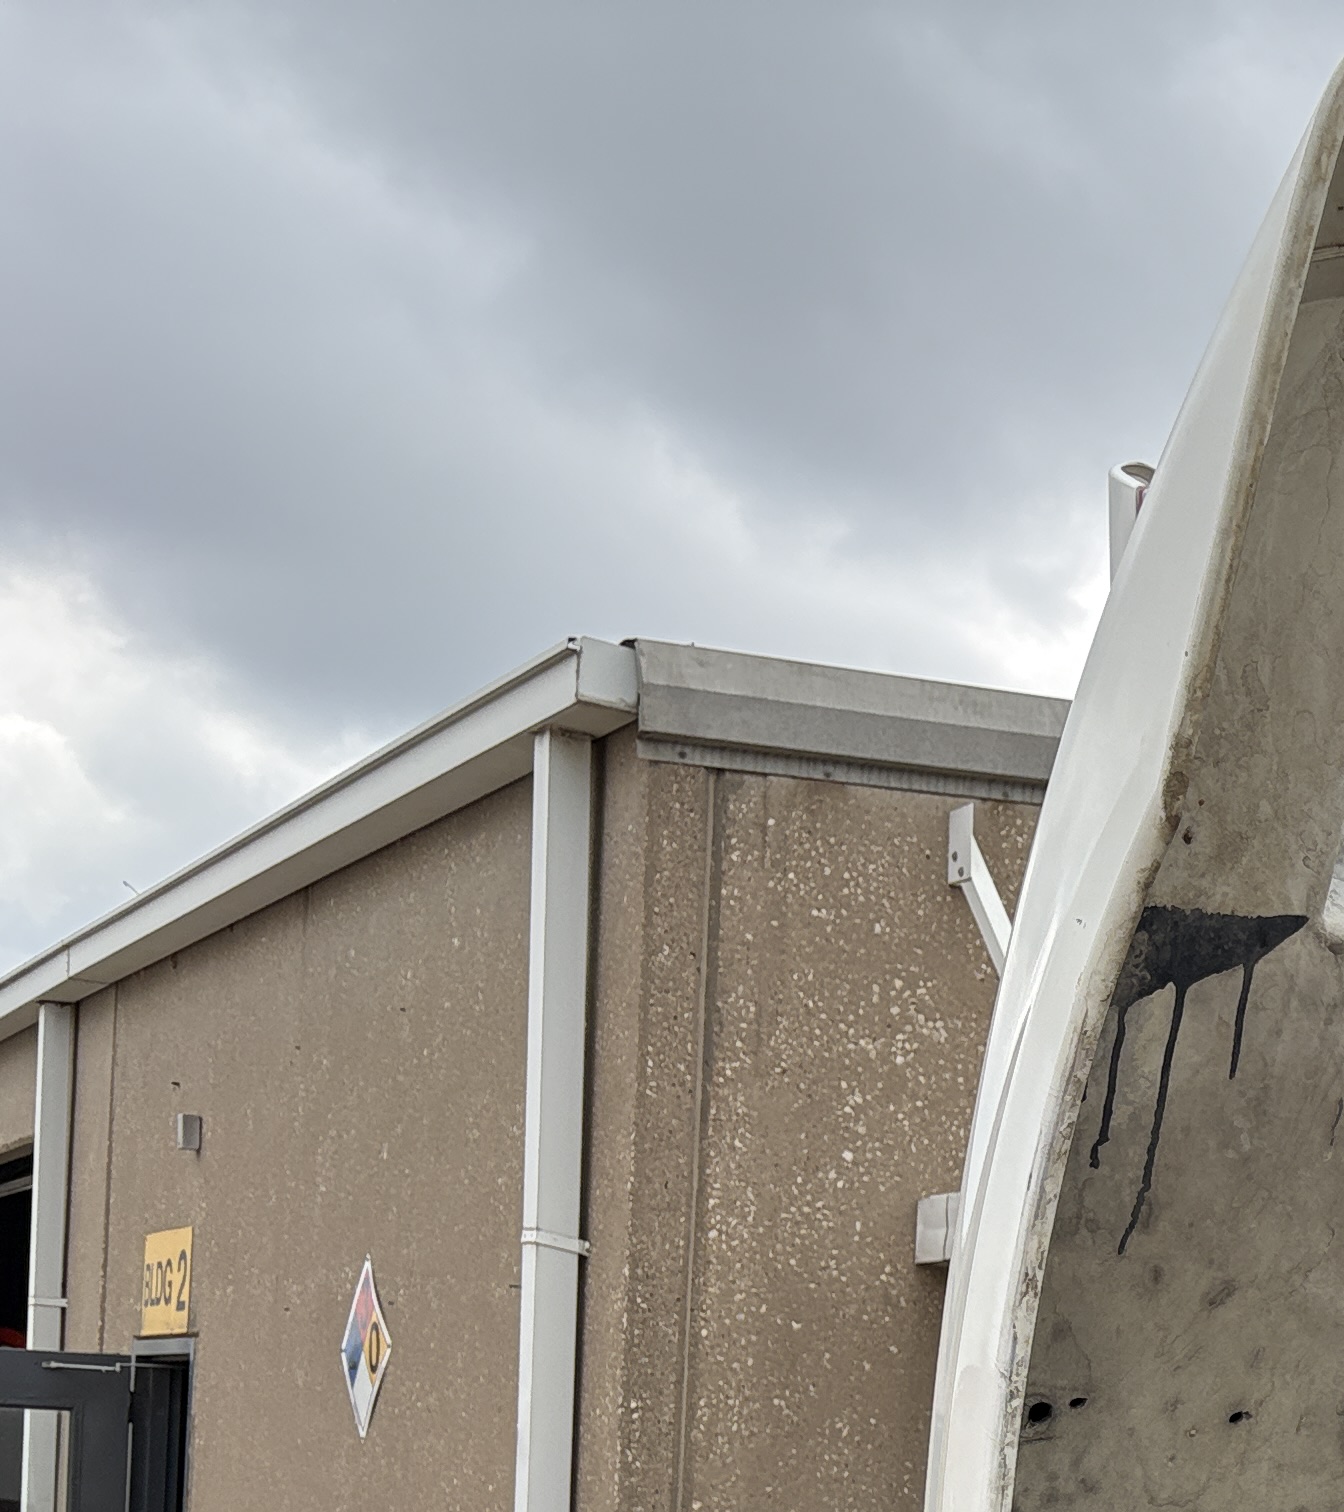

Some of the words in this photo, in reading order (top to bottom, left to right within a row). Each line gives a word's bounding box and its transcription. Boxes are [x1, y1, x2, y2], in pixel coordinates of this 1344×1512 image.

[143, 1258, 173, 1308] BLDG
[176, 1248, 188, 1312] 2
[368, 1321, 381, 1375] 0
